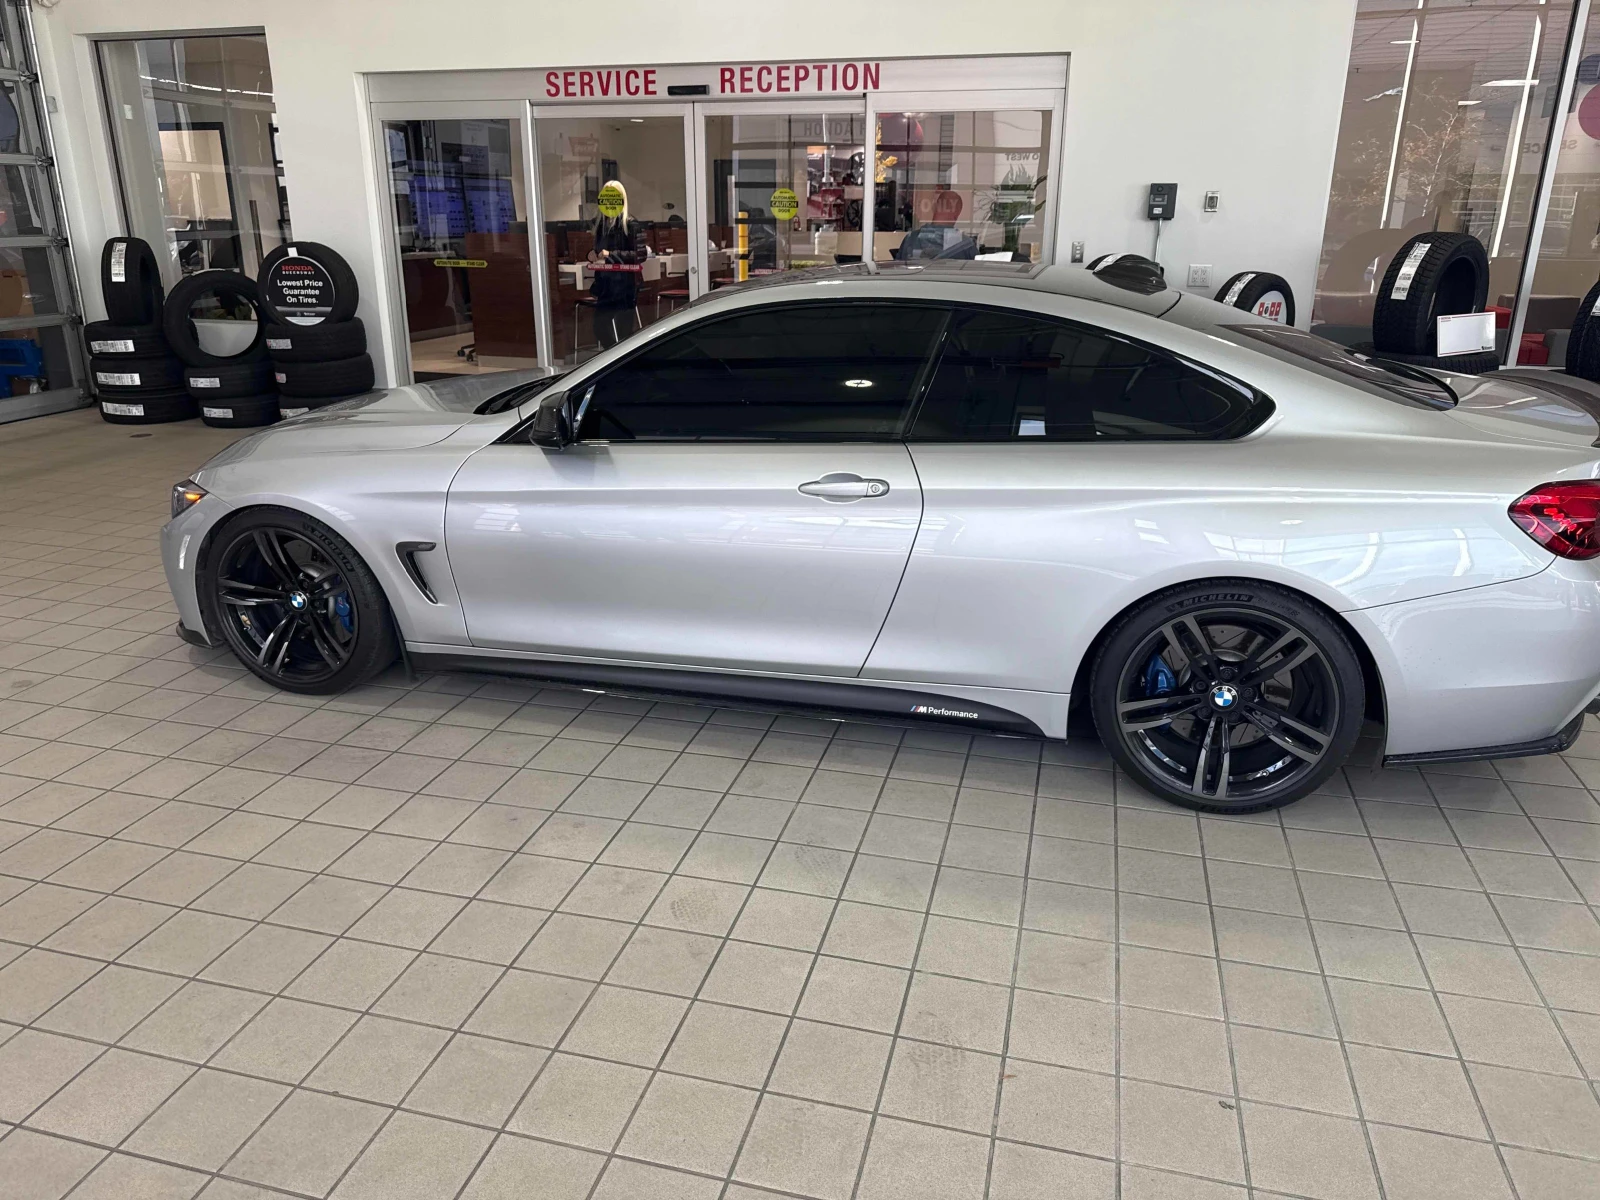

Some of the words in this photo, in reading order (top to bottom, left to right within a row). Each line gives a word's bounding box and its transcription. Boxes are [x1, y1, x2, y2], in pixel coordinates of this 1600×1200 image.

[546, 69, 657, 97] SERVICE
[720, 63, 880, 94] RECEPTION
[1182, 593, 1250, 607] MICHELIN
[928, 707, 979, 719] Performance
